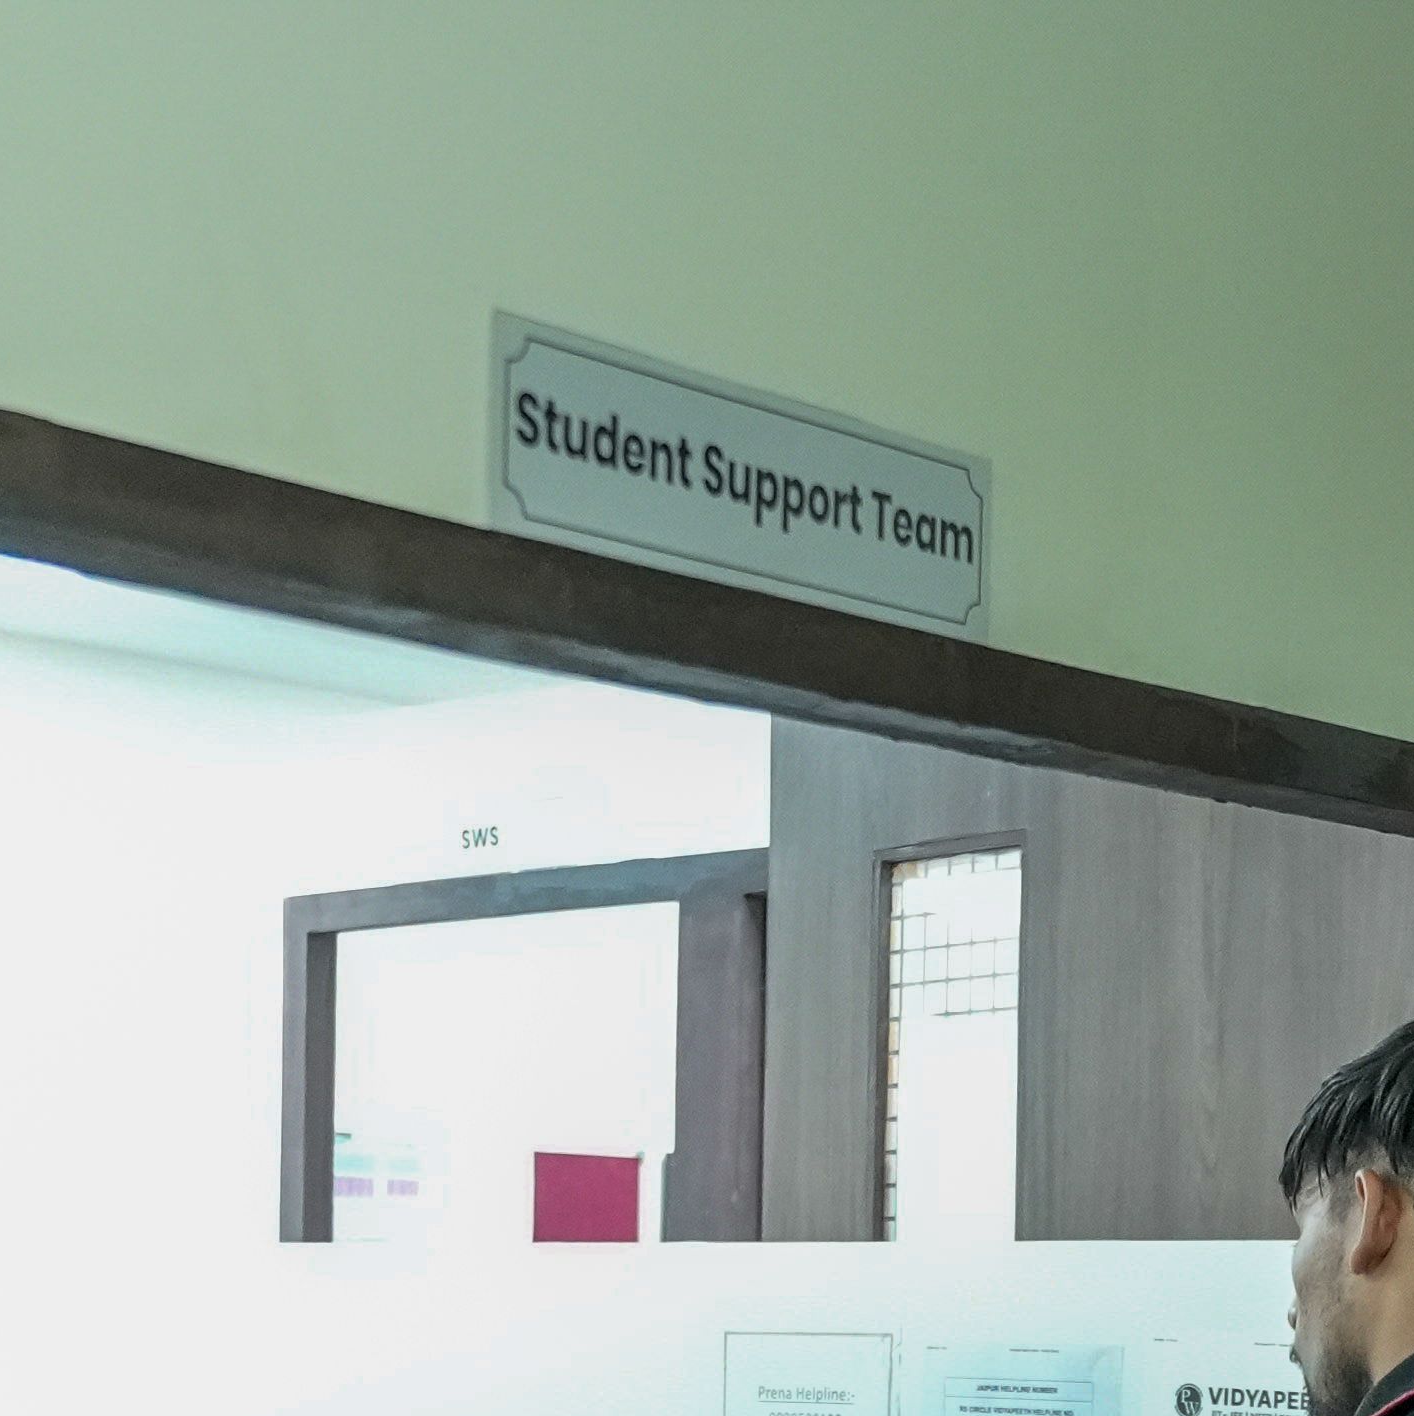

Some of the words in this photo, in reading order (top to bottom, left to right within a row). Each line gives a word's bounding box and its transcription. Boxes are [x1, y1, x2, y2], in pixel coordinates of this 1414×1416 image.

[516, 392, 691, 488] Student
[702, 444, 863, 533] Support
[871, 490, 974, 563] Team
[462, 826, 498, 849] SWS
[758, 1386, 792, 1400] Prena
[796, 1387, 855, 1403] Helpline:-
